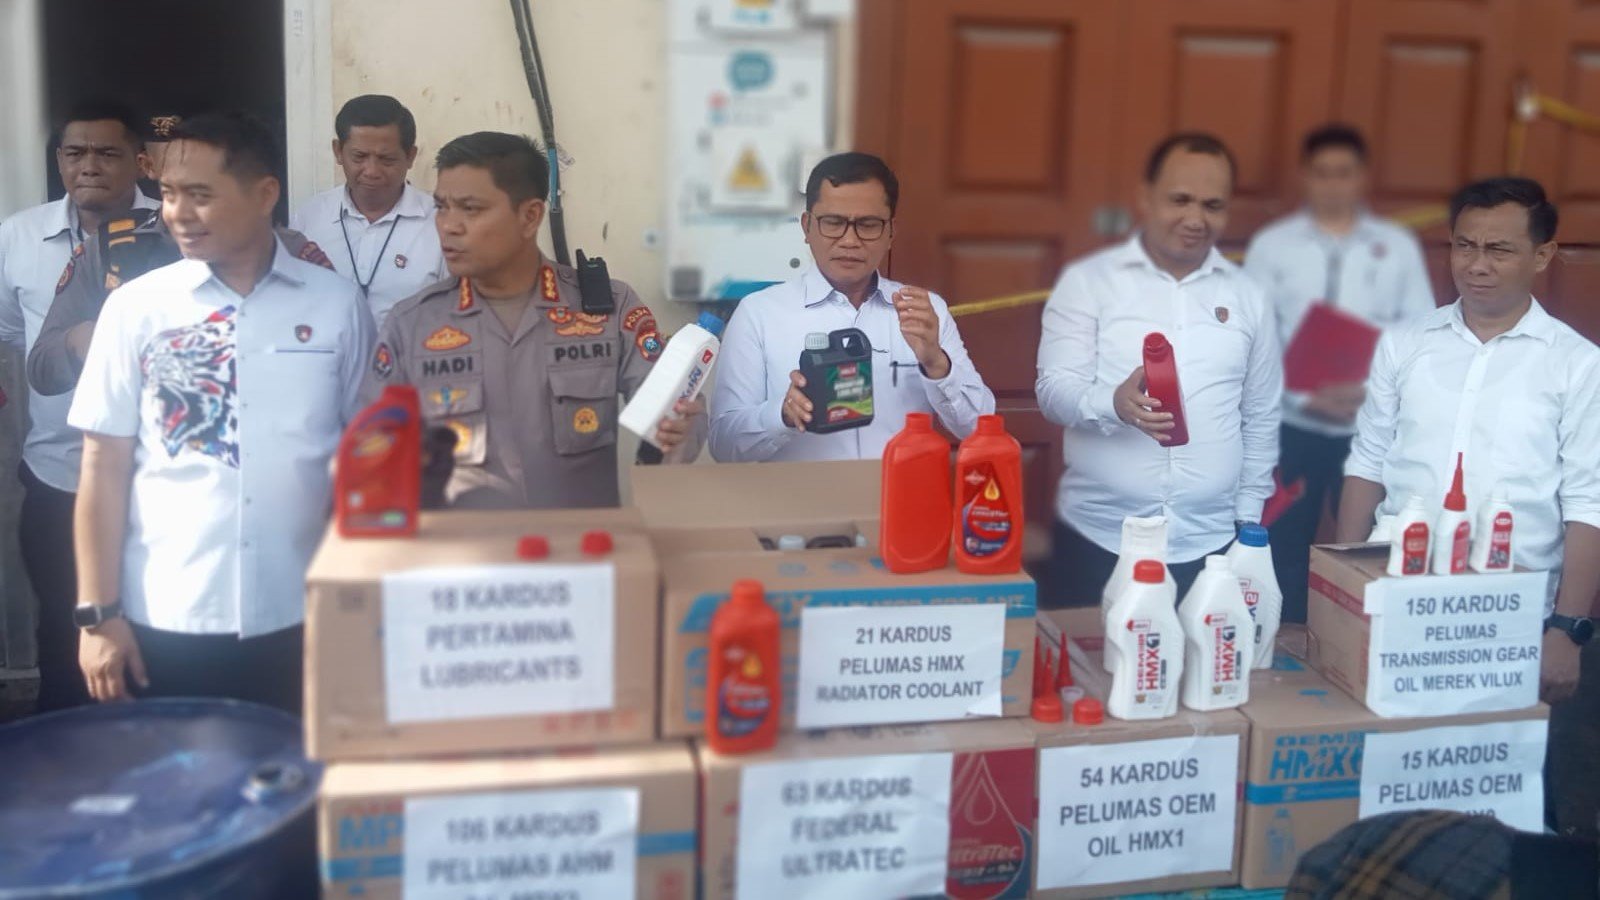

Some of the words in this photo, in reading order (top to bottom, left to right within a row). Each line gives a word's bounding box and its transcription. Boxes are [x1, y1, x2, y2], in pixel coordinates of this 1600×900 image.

[422, 356, 473, 377] HADI
[554, 343, 612, 362] POLRI
[463, 580, 571, 609] KARDUS
[1406, 597, 1437, 617] 150
[1441, 593, 1521, 615] KARDUS
[426, 618, 575, 650] PERTAMINA
[855, 628, 874, 645] 21
[879, 625, 952, 644] KARDUS
[1425, 623, 1498, 642] PELUMAS
[839, 656, 923, 676] PELUMAS
[926, 655, 965, 672] HMX
[1379, 648, 1492, 669] TRANSMISSION
[1496, 645, 1539, 662] GEAR
[420, 654, 582, 689] LUBRICANTS
[1394, 676, 1419, 693] OIL
[1422, 673, 1477, 691] MEREK
[1479, 671, 1523, 688] VILUX
[816, 684, 902, 702] RADIATOR
[905, 680, 984, 699] COOLANT
[1401, 751, 1423, 770] 15
[1427, 742, 1509, 768] KARDUS
[1080, 767, 1104, 788] 54
[1110, 758, 1199, 786] KARDUS
[813, 776, 912, 803] KARDUS
[1378, 777, 1474, 804] PELUMAS
[1478, 773, 1523, 795] OEM
[1060, 796, 1163, 826] PELUMAS
[1168, 792, 1216, 816] OEM
[493, 810, 600, 839] KARDUS
[790, 811, 899, 843] FEDERAL
[1087, 836, 1122, 858] OIL
[1129, 828, 1185, 853] HMX1
[427, 853, 550, 884] PELUMAS
[555, 848, 615, 875] AHM
[781, 847, 905, 879] ULTRATEC
